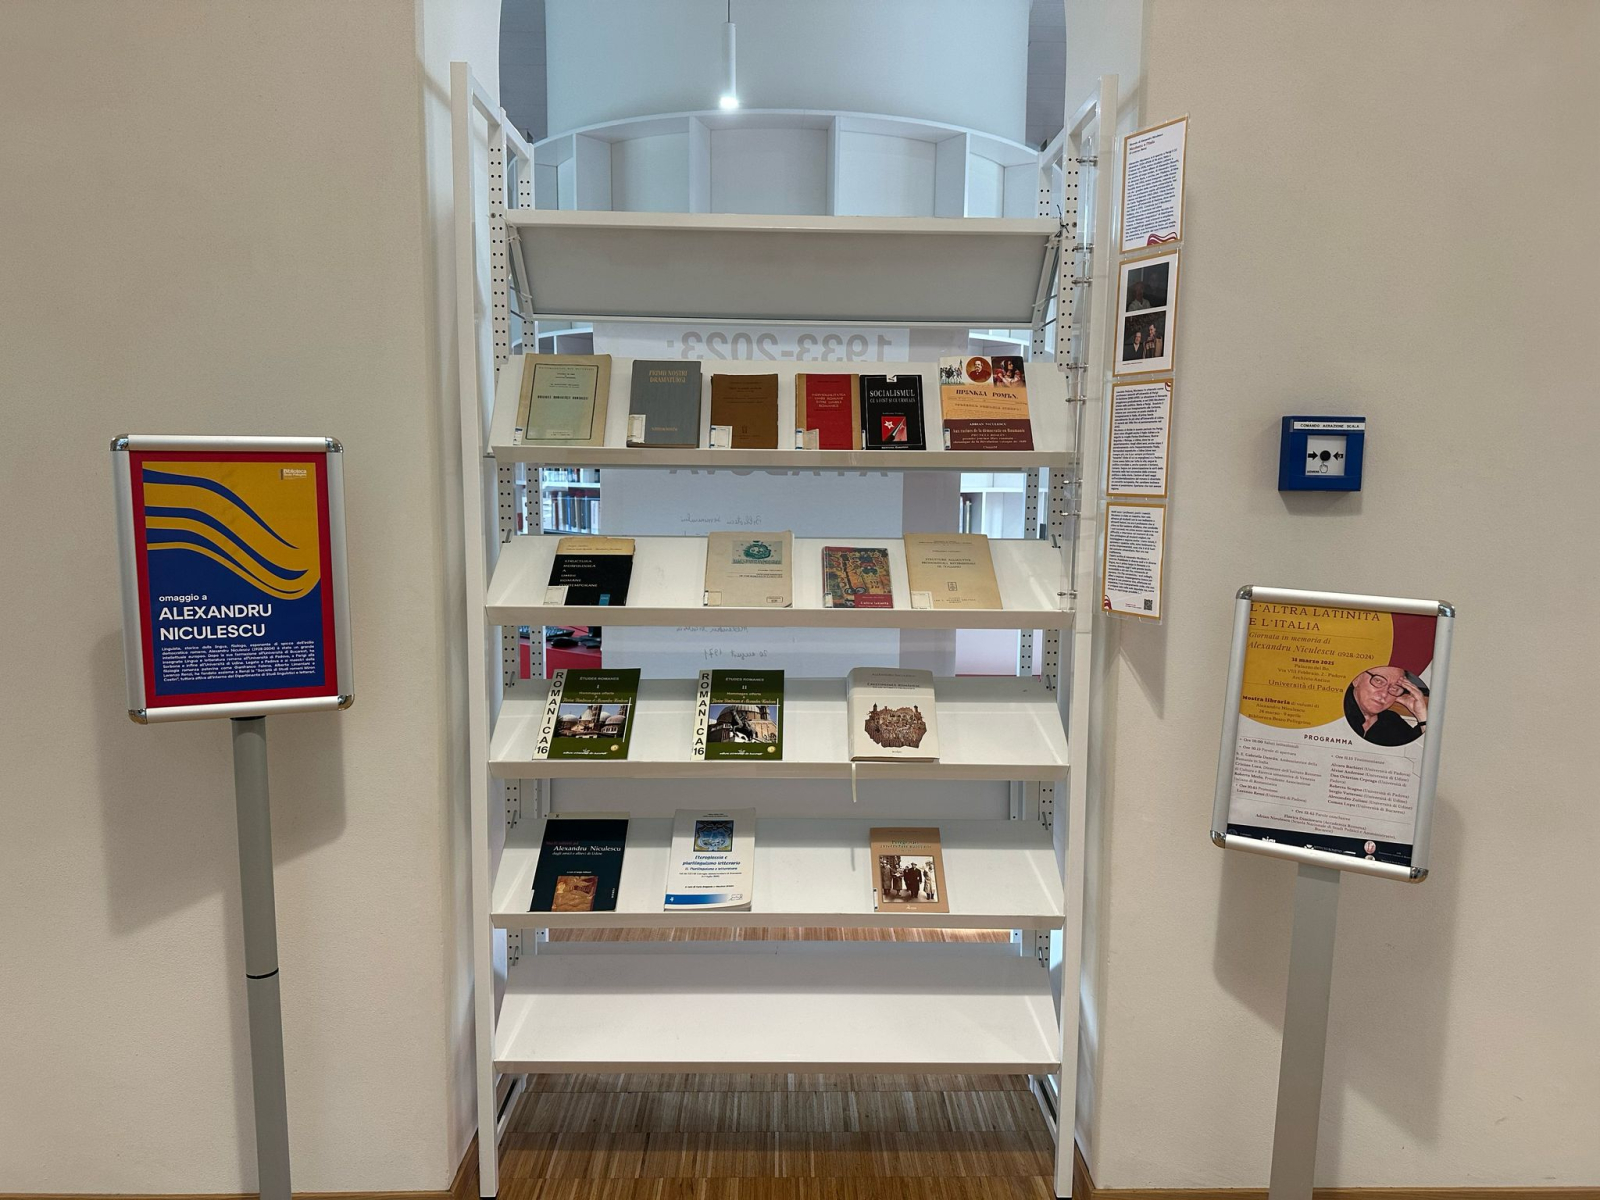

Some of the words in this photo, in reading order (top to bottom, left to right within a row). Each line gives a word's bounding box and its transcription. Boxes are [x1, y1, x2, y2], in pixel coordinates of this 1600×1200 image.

[159, 594, 199, 602] omaggio
[159, 604, 272, 620] ALEXANDRU
[1250, 604, 1308, 615] L'ALTRA
[1313, 608, 1380, 621] LATINITÀ
[1262, 619, 1320, 630] L'ITALIA
[160, 624, 266, 640] NICULESCU
[1249, 632, 1279, 640] Giornata
[1248, 642, 1291, 651] Alexandru
[1293, 645, 1335, 656] Niculescu
[1268, 680, 1306, 689] Università
[1317, 684, 1343, 693] Padova
[540, 672, 564, 744] ROMANICA
[695, 673, 709, 745] ROMANICA
[1304, 734, 1352, 745] PROGRAMMA
